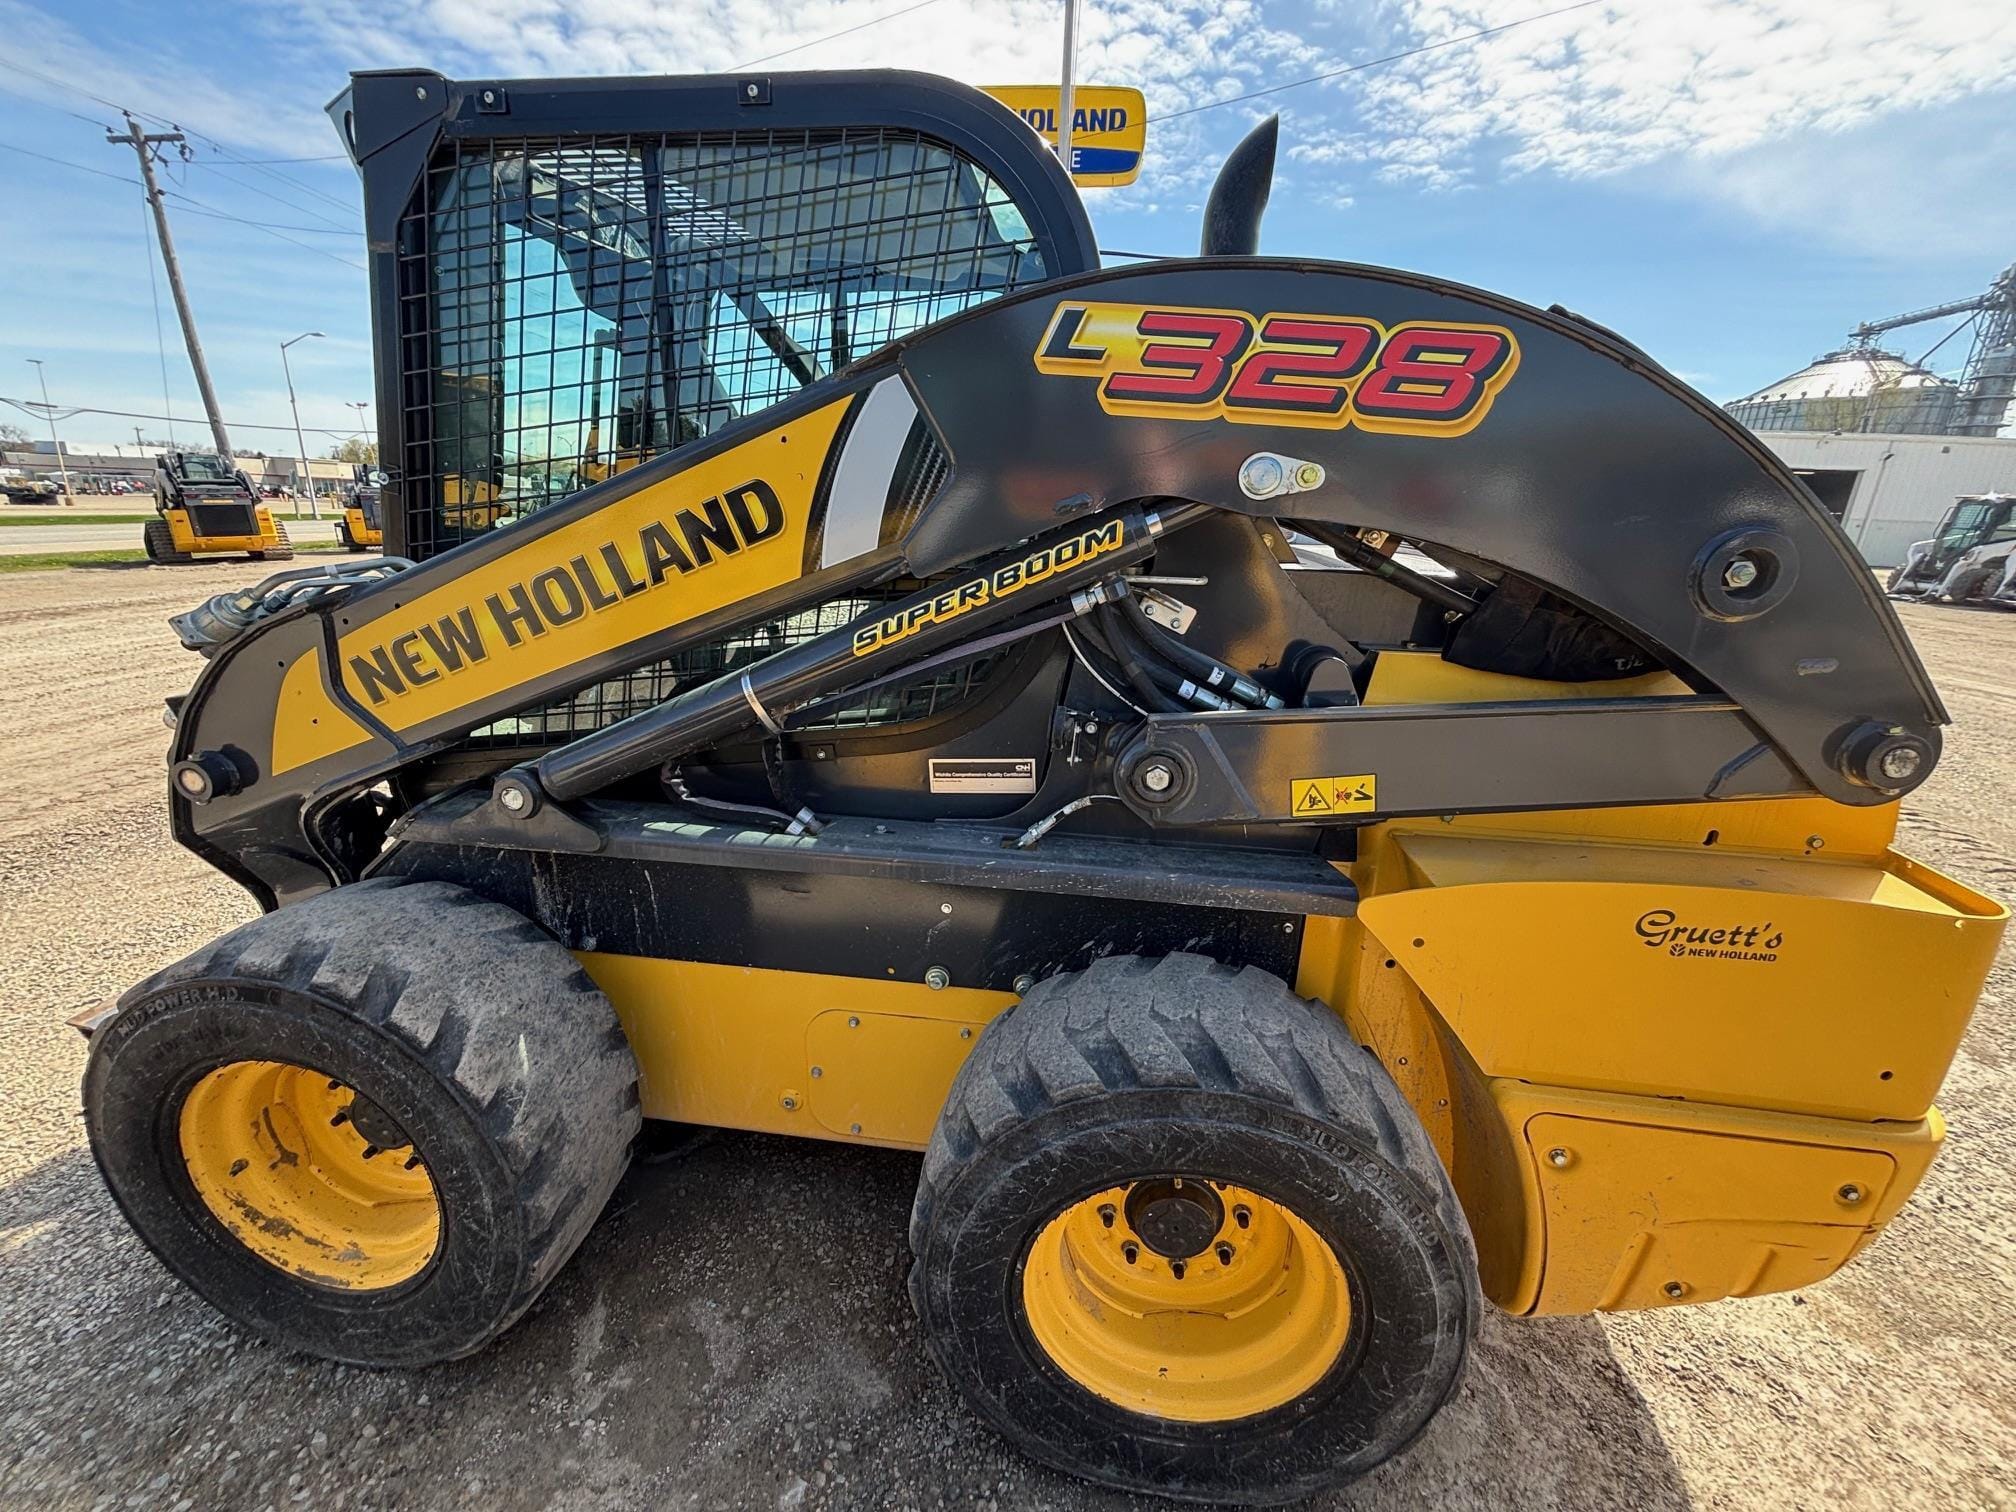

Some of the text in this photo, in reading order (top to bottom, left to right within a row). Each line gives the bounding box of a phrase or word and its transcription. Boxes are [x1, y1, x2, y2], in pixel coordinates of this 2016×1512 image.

[1012, 108, 1127, 132] OLAND
[349, 479, 785, 704] NEW HOLLAND
[854, 519, 1124, 657] SUPER BOOM
[1635, 909, 1782, 949] Gruett's
[1688, 948, 1777, 962] NEW HOLLAND
[145, 988, 201, 1017] POWER
